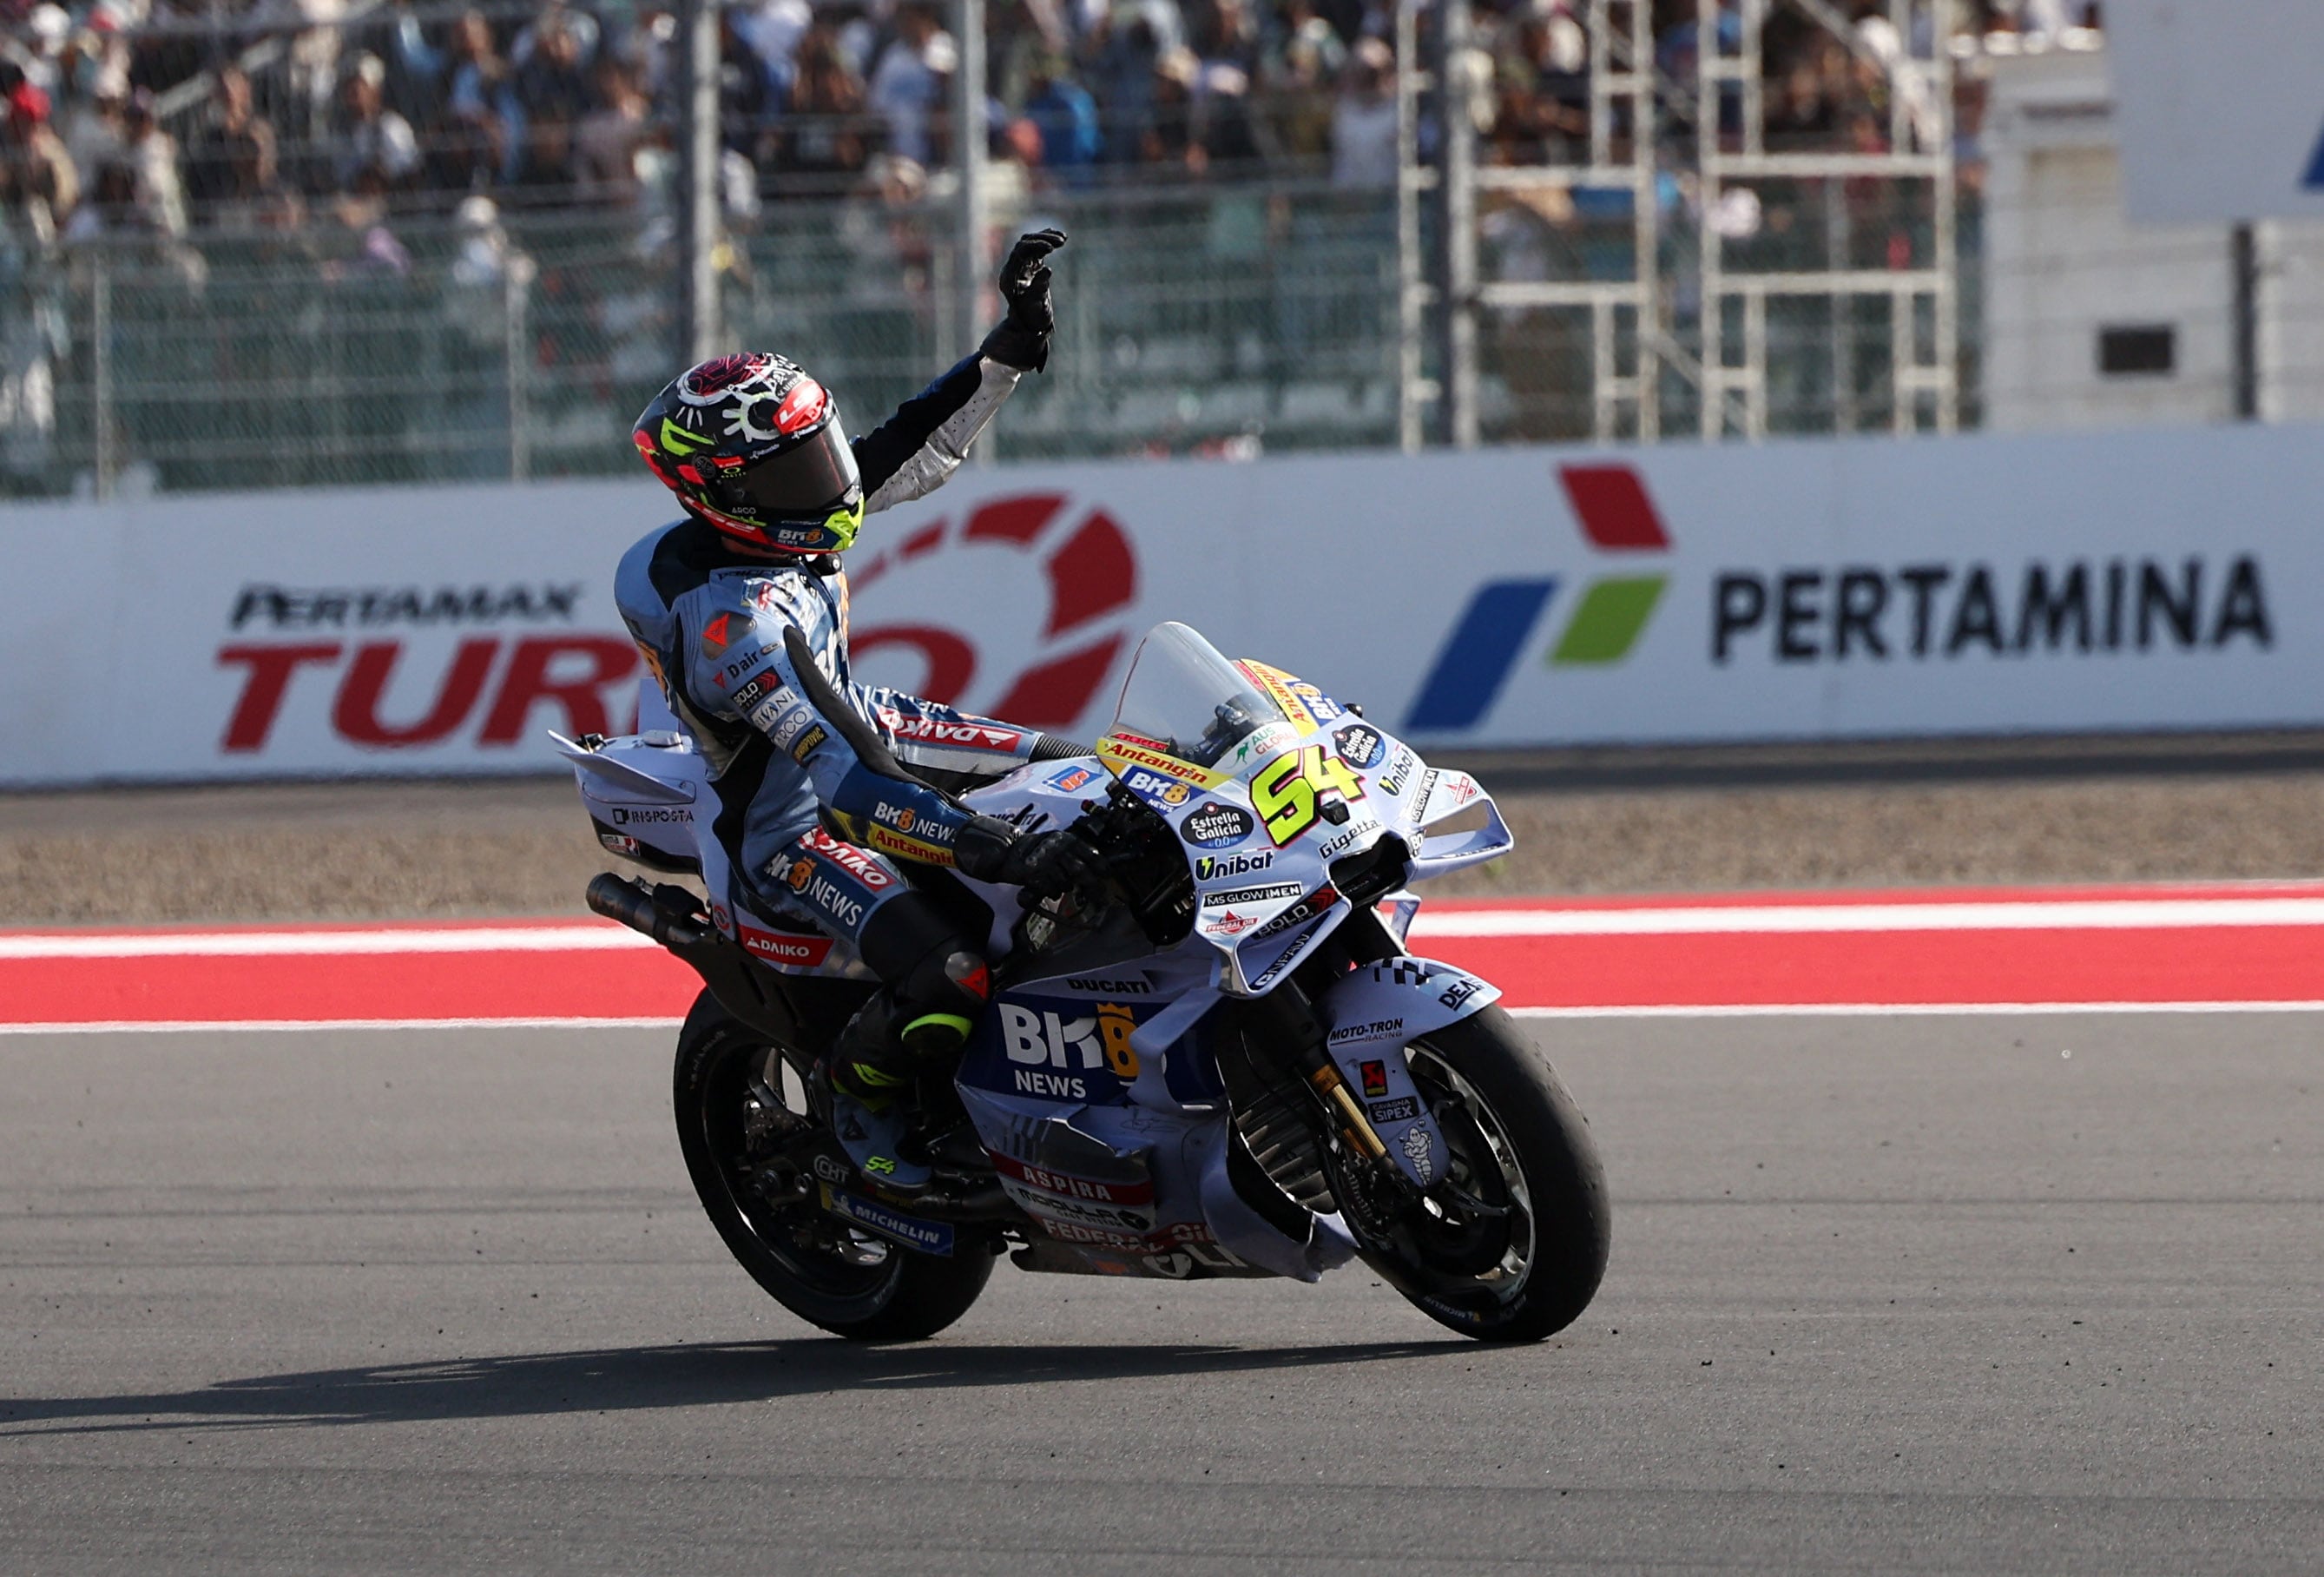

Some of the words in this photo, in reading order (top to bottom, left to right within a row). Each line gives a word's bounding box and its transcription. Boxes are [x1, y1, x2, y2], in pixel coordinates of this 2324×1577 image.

[229, 580, 583, 630] PERTAMAX
[1708, 551, 2276, 665] PERTAMINA
[1251, 727, 1276, 746] AUS
[1105, 743, 1208, 783] Antangin
[1379, 748, 1415, 796] Unibat
[1129, 772, 1190, 805] BK8
[1250, 744, 1368, 849] 54
[631, 810, 694, 823] RISPOSTA
[874, 802, 915, 832] BK8
[1147, 799, 1174, 813] NEWS
[1190, 811, 1241, 829] Estrella
[1195, 824, 1241, 840] Galicia
[1318, 819, 1381, 859] Gigetta
[1195, 851, 1273, 881] Unibat
[809, 875, 862, 927] NEWS
[1207, 895, 1226, 906] MS
[1227, 890, 1264, 902] GLOW
[1269, 887, 1300, 899] MEN
[1258, 904, 1309, 937] BOLD
[760, 940, 810, 957] DAIKO
[1067, 978, 1150, 993] DUCATI
[998, 1002, 1139, 1078] BK8
[1330, 1018, 1403, 1041] MOTO-TRON
[1365, 1032, 1402, 1043] RACING
[1015, 1069, 1086, 1099] NEWS
[1375, 1105, 1413, 1122] SIPEX
[866, 1156, 896, 1175] 54
[855, 1205, 940, 1244] MICHELIN
[1043, 1218, 1164, 1253] FEDERAL
